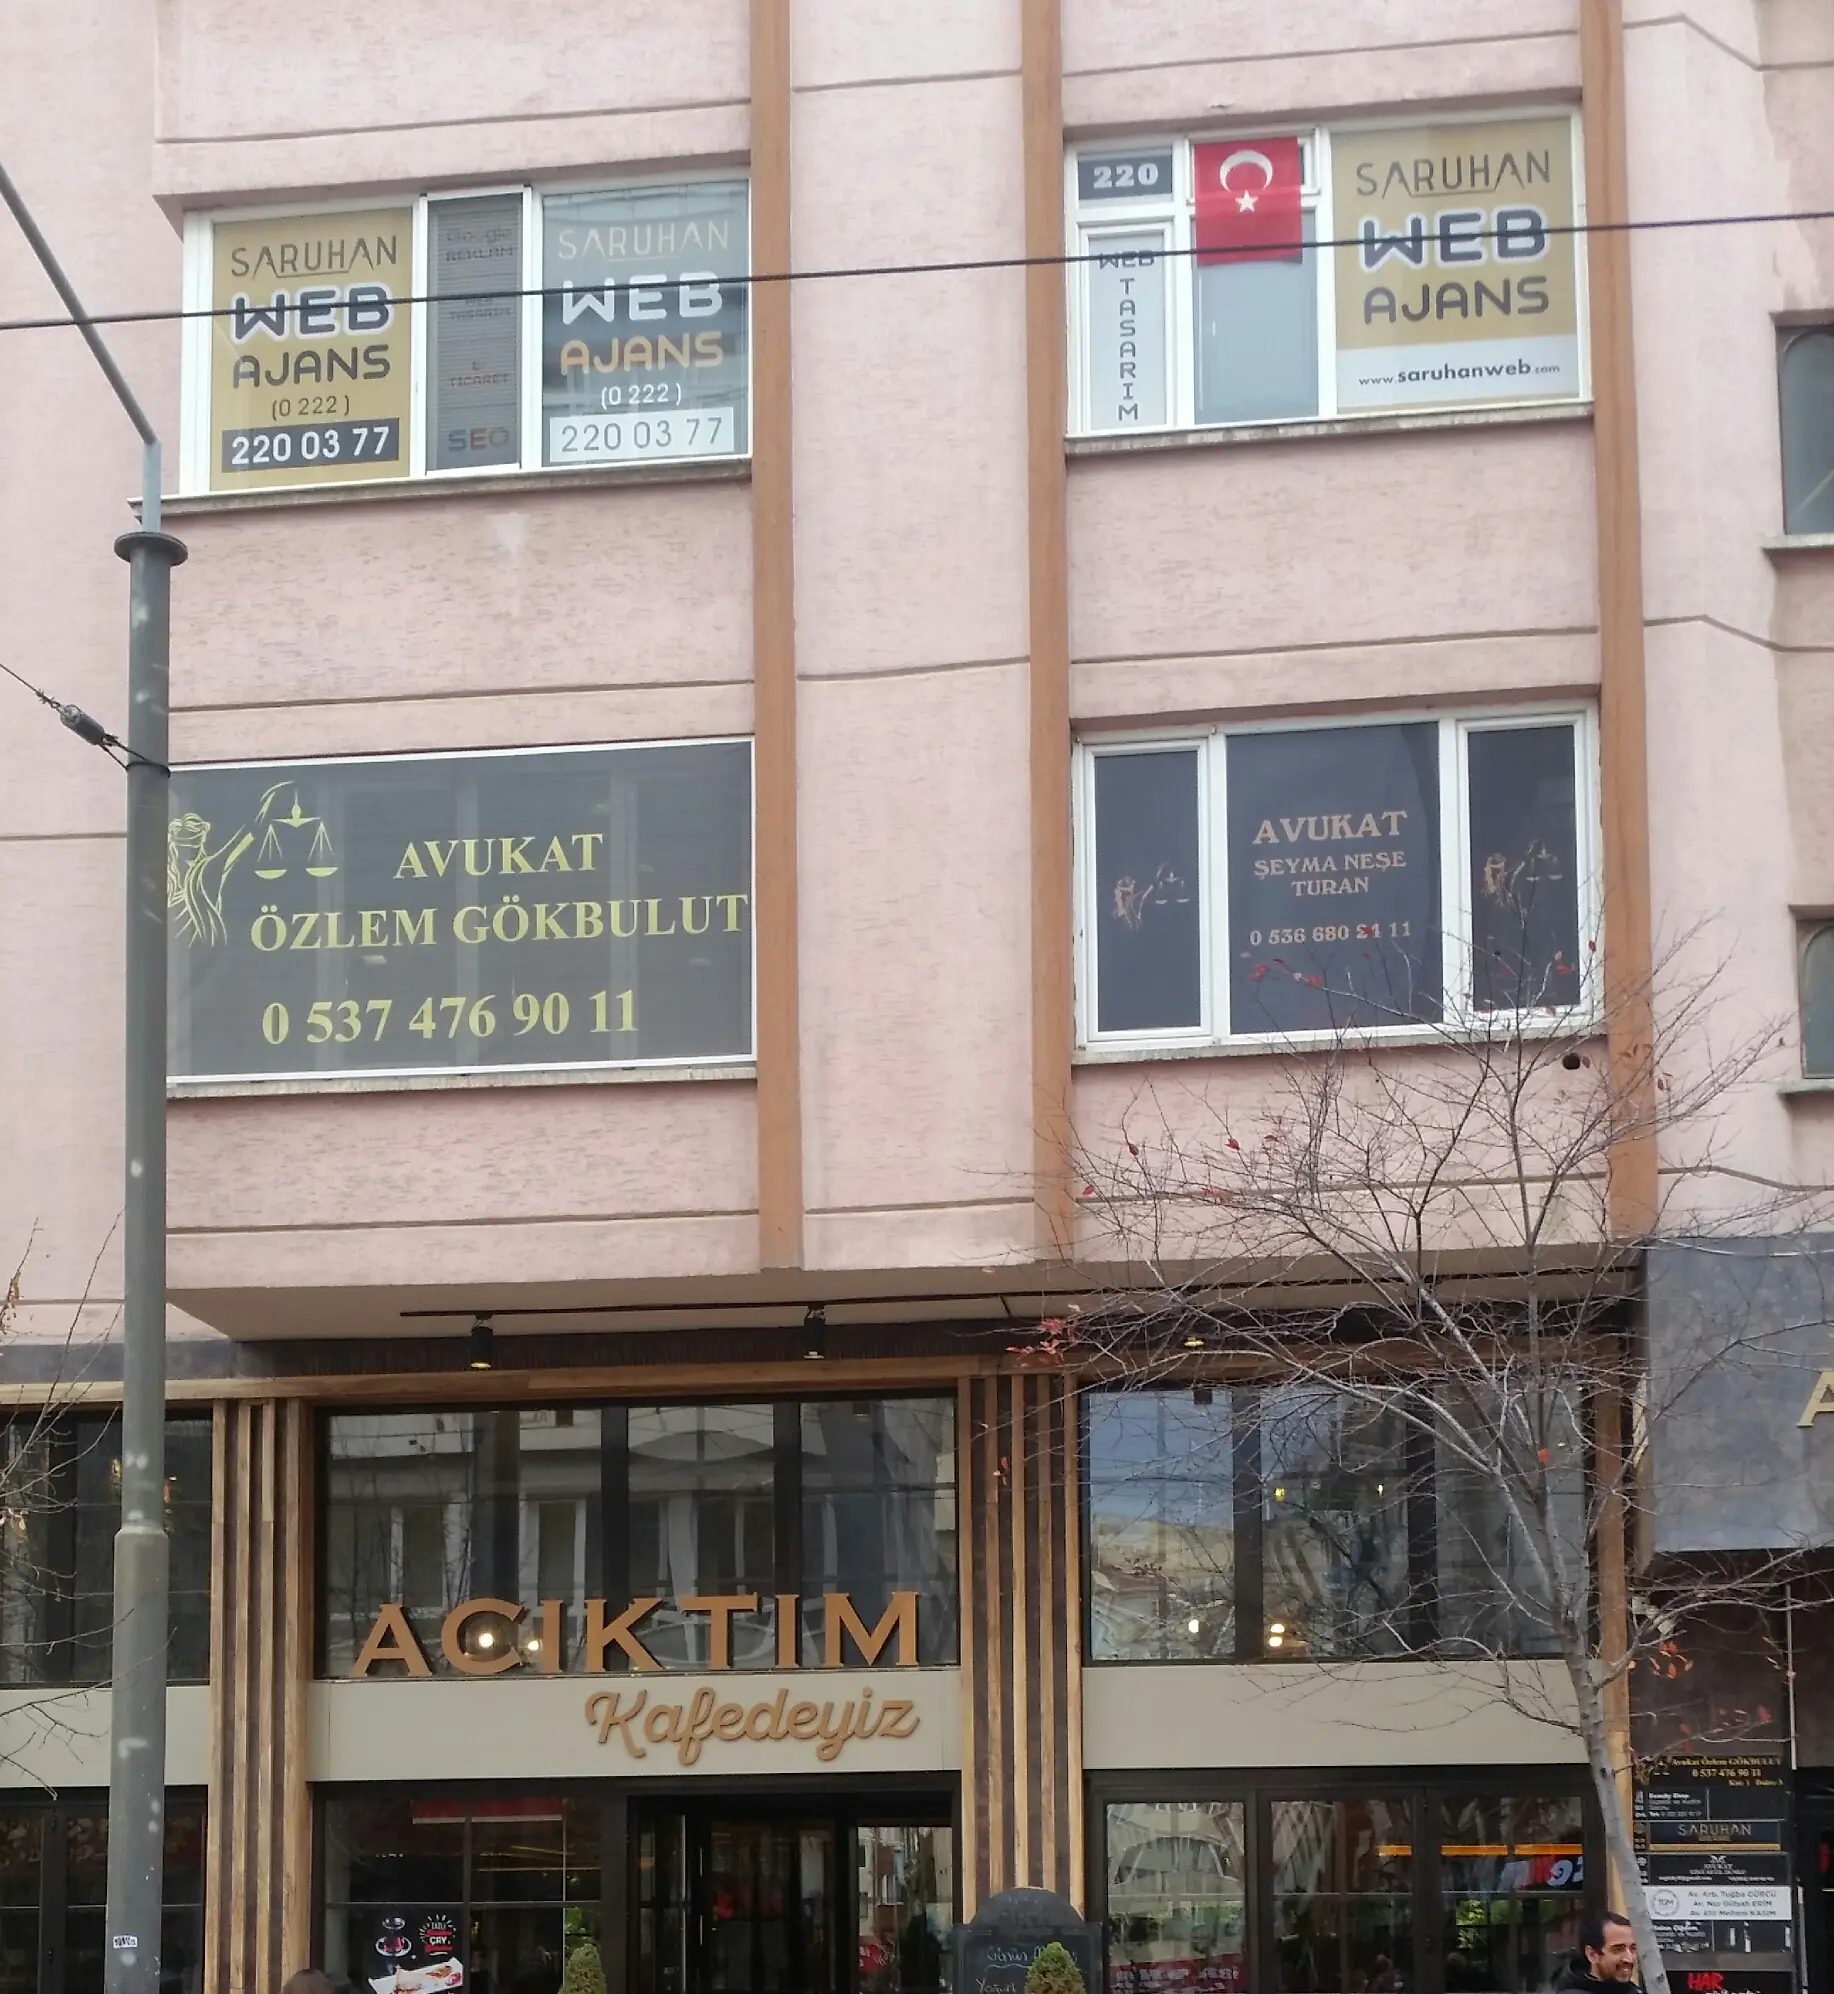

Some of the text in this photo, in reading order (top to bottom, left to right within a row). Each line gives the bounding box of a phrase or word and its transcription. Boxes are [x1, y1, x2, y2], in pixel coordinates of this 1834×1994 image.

[1092, 162, 1158, 190] 220
[1356, 150, 1549, 199] SARUHAN
[231, 235, 397, 280] SARUHAN
[558, 220, 729, 262] SARUHAN
[1361, 206, 1547, 270] WEB
[233, 285, 391, 342] WEB
[562, 271, 723, 325] WEB
[1364, 275, 1549, 325] AJANS
[233, 344, 391, 389] AJANS
[561, 331, 724, 376] AJANS
[1117, 277, 1139, 421] TASARIM
[1358, 358, 1561, 386] www.saruhanweb.com
[231, 426, 390, 465] 220 03 77
[448, 427, 509, 452] SEO
[561, 417, 722, 453] 220 03 77
[1252, 810, 1408, 845] AVUKAT
[393, 832, 603, 880] AVUKAT
[1254, 851, 1407, 880] ŞEYMA NEŞE
[1291, 876, 1369, 897] TURAN
[251, 893, 748, 952] ÖZLEM GÖKBULUT
[1250, 930, 1262, 946] 0
[1268, 927, 1306, 945] 536
[1312, 923, 1349, 942] 680
[1390, 921, 1410, 938] 11
[262, 988, 639, 1045] 0 537 476 90 11
[350, 1592, 920, 1678] ACIKTIM
[585, 1685, 920, 1766] Kafedeyiz
[1677, 1823, 1752, 1837] SARUHAN
